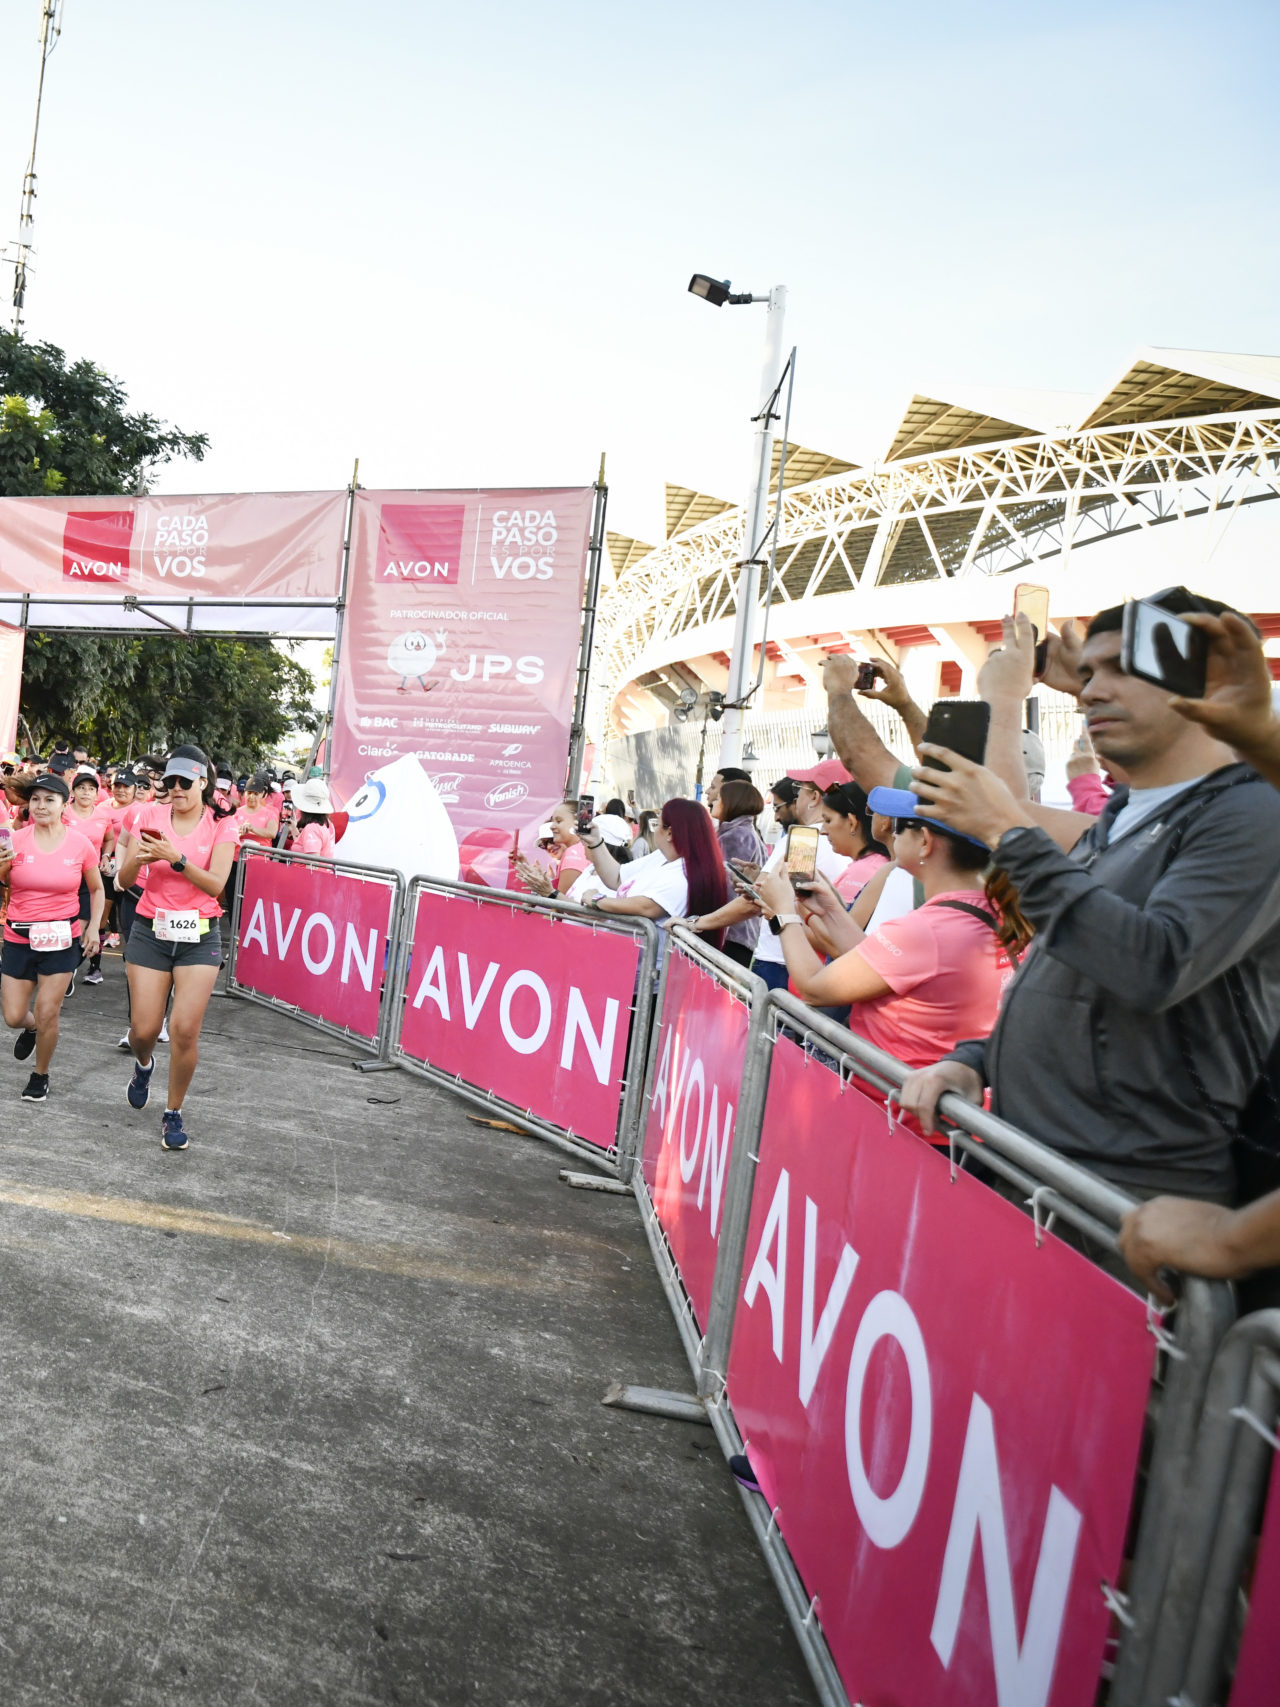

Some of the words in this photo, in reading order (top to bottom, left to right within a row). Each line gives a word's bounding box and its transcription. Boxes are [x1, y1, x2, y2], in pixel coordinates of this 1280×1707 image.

[156, 515, 208, 530] CADA
[492, 510, 557, 527] CADA
[154, 530, 209, 546] PASO
[491, 527, 558, 546] PASO
[153, 546, 170, 556] ES
[177, 546, 207, 556] POR
[490, 546, 509, 557] ES
[519, 546, 556, 557] POR
[69, 561, 122, 576] AVON
[153, 556, 206, 577] VOS
[383, 561, 449, 577] AVON
[490, 556, 555, 580] VOS
[390, 609, 468, 620] PATROCINADOR
[469, 611, 510, 621] OFICIAL
[450, 653, 545, 684] JPS
[373, 717, 398, 728] BAC
[488, 723, 541, 735] SUBWAY
[358, 744, 392, 757] Claro
[416, 751, 475, 762] GATORADE
[489, 784, 525, 806] Vanish
[170, 919, 197, 929] 1626
[31, 932, 58, 945] 999
[242, 898, 379, 992] AVON
[412, 945, 620, 1086] AVON
[652, 1024, 733, 1239] AVON
[744, 1168, 1083, 1707] AVON
